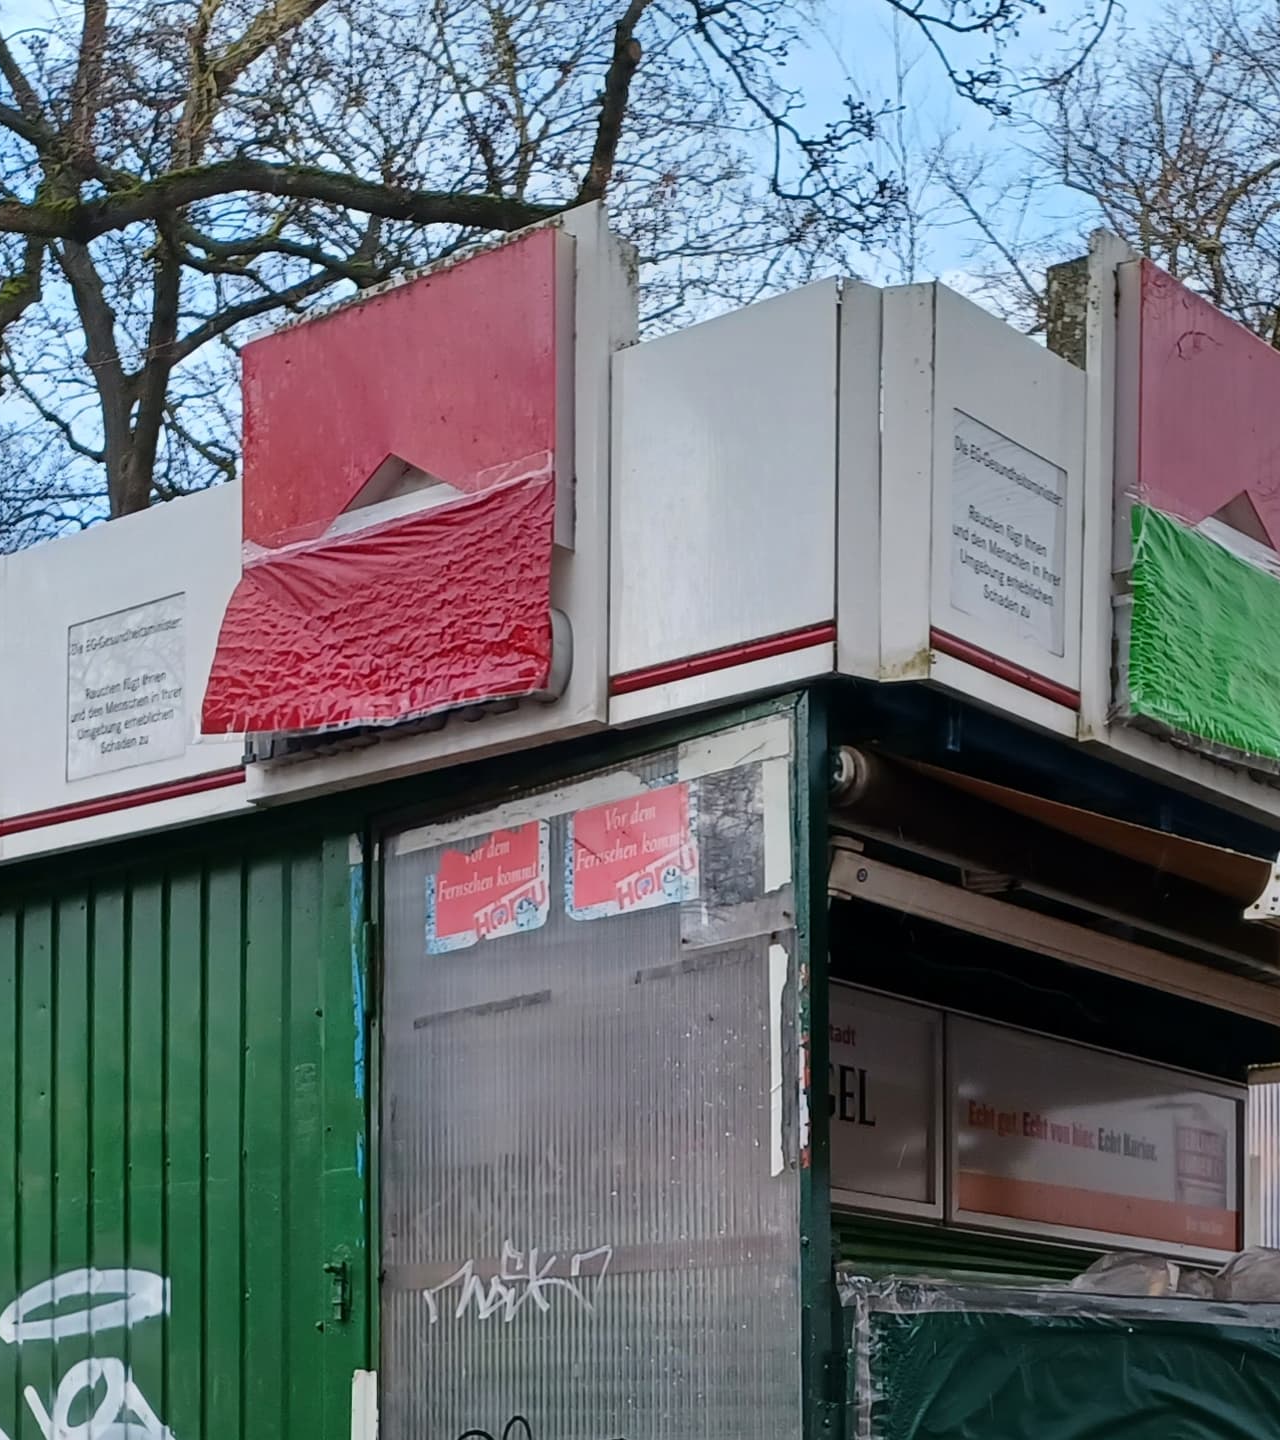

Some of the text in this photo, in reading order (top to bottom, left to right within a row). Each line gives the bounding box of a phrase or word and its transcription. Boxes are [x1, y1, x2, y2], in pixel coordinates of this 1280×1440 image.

[969, 504, 1004, 536] Rauchen
[952, 524, 969, 541] und
[971, 530, 987, 550] den
[989, 540, 1030, 572] Menschen
[1032, 560, 1040, 576] in
[960, 548, 1004, 586] Umgebung
[984, 584, 1019, 614] Schaden
[71, 707, 86, 723] und
[88, 707, 103, 719] den
[105, 695, 149, 714] Menschen
[151, 690, 160, 703] in
[85, 682, 121, 700] Rauchen
[77, 721, 122, 741] Umgebung
[100, 735, 149, 754] Schaden zu
[605, 800, 656, 831] Vor dem
[487, 835, 510, 858] dem
[576, 838, 637, 872] Fernsehen
[438, 871, 493, 903] Fernsehen
[1023, 1111, 1048, 1140] Echt
[1098, 1127, 1121, 1154] Echt
